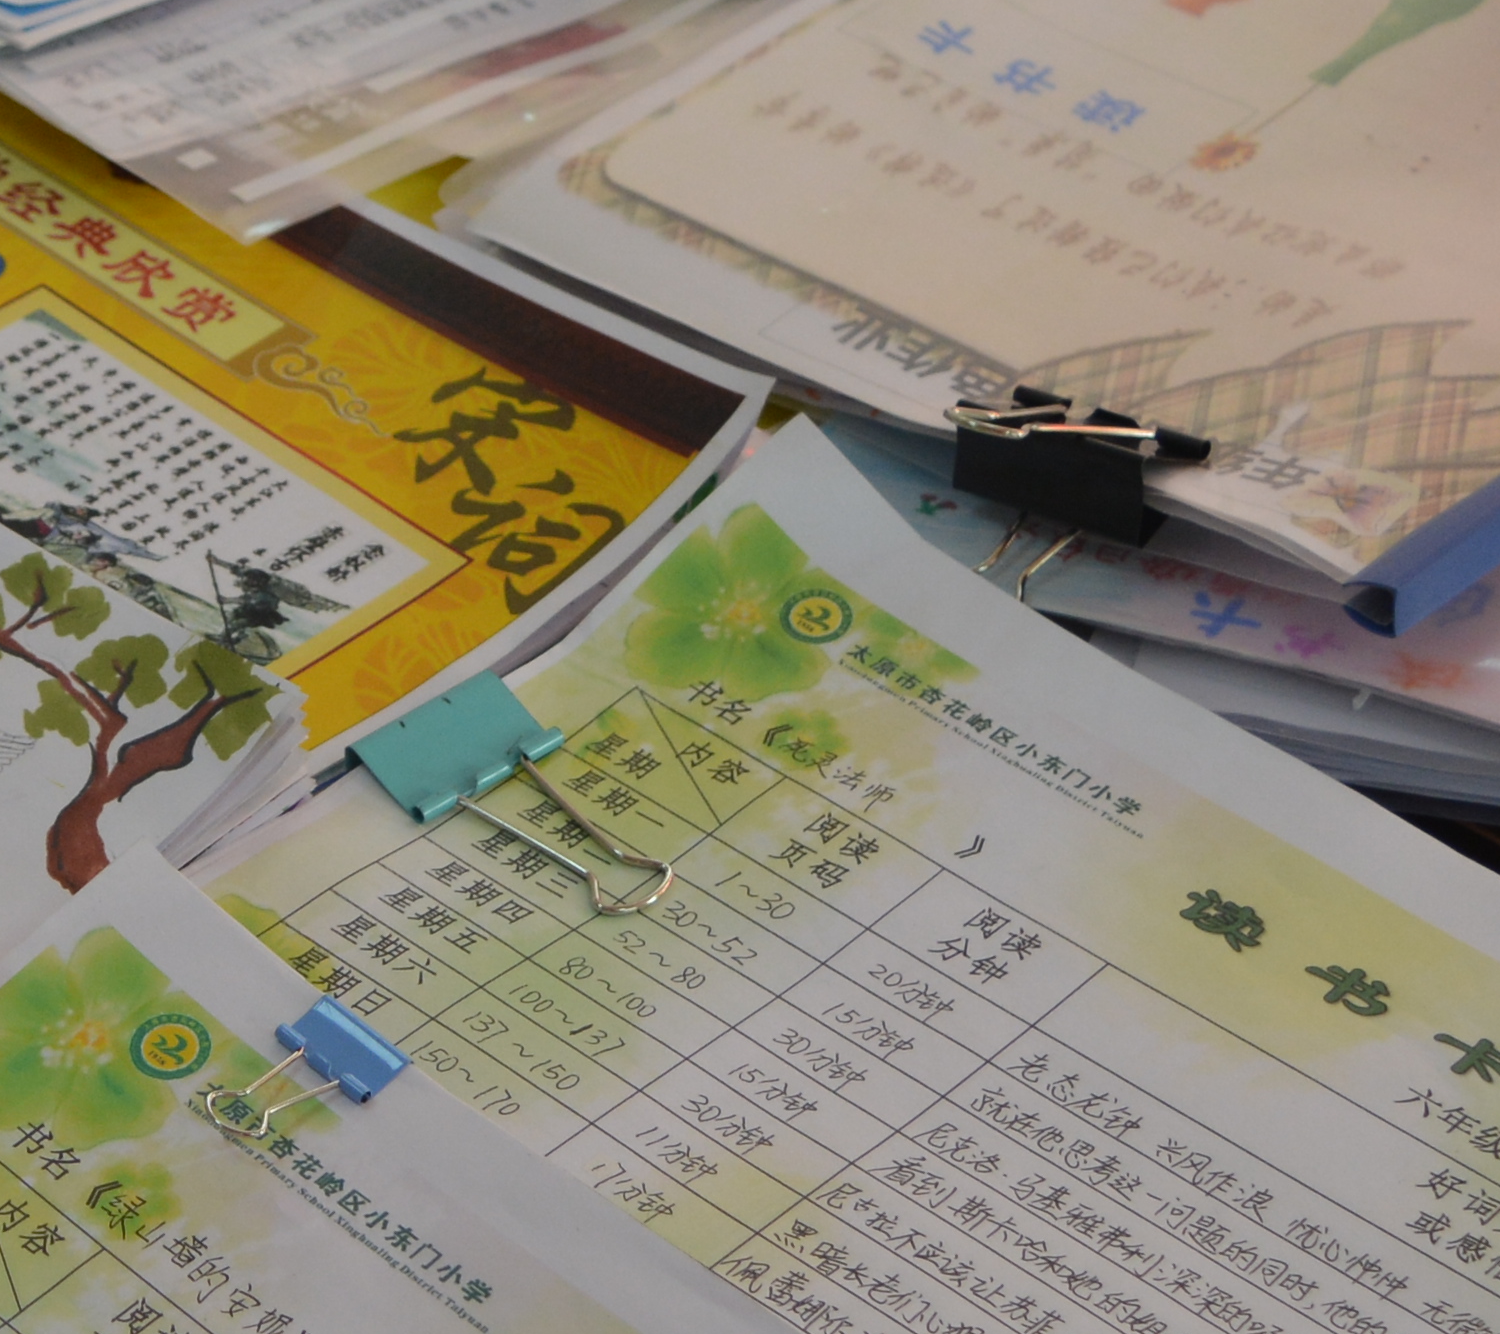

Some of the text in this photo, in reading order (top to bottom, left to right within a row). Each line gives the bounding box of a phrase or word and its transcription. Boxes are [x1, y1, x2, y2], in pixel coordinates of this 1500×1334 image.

[918, 20, 1146, 133] 读书卡
[388, 364, 626, 615] 宋词
[687, 680, 753, 727] 书名
[846, 645, 1143, 817] 太原市杏花岭区小东门小学
[582, 731, 663, 781] 星期
[673, 741, 751, 786] 内容
[528, 797, 627, 867] 星期二
[571, 769, 666, 829] 星期一
[480, 822, 587, 900] 星期三
[767, 837, 851, 891] 页码
[802, 811, 881, 866] 阅读
[378, 885, 489, 956] 星期五
[424, 860, 536, 926] 星期四
[330, 913, 438, 987] 星期六
[927, 936, 1010, 985] 分钟
[962, 906, 1043, 962] 阅读
[286, 945, 394, 1017] 星期日
[11, 1121, 82, 1182] 书名
[1006, 1052, 1144, 1147] 老态龙钟
[1143, 1136, 1276, 1229] 兴风作浪
